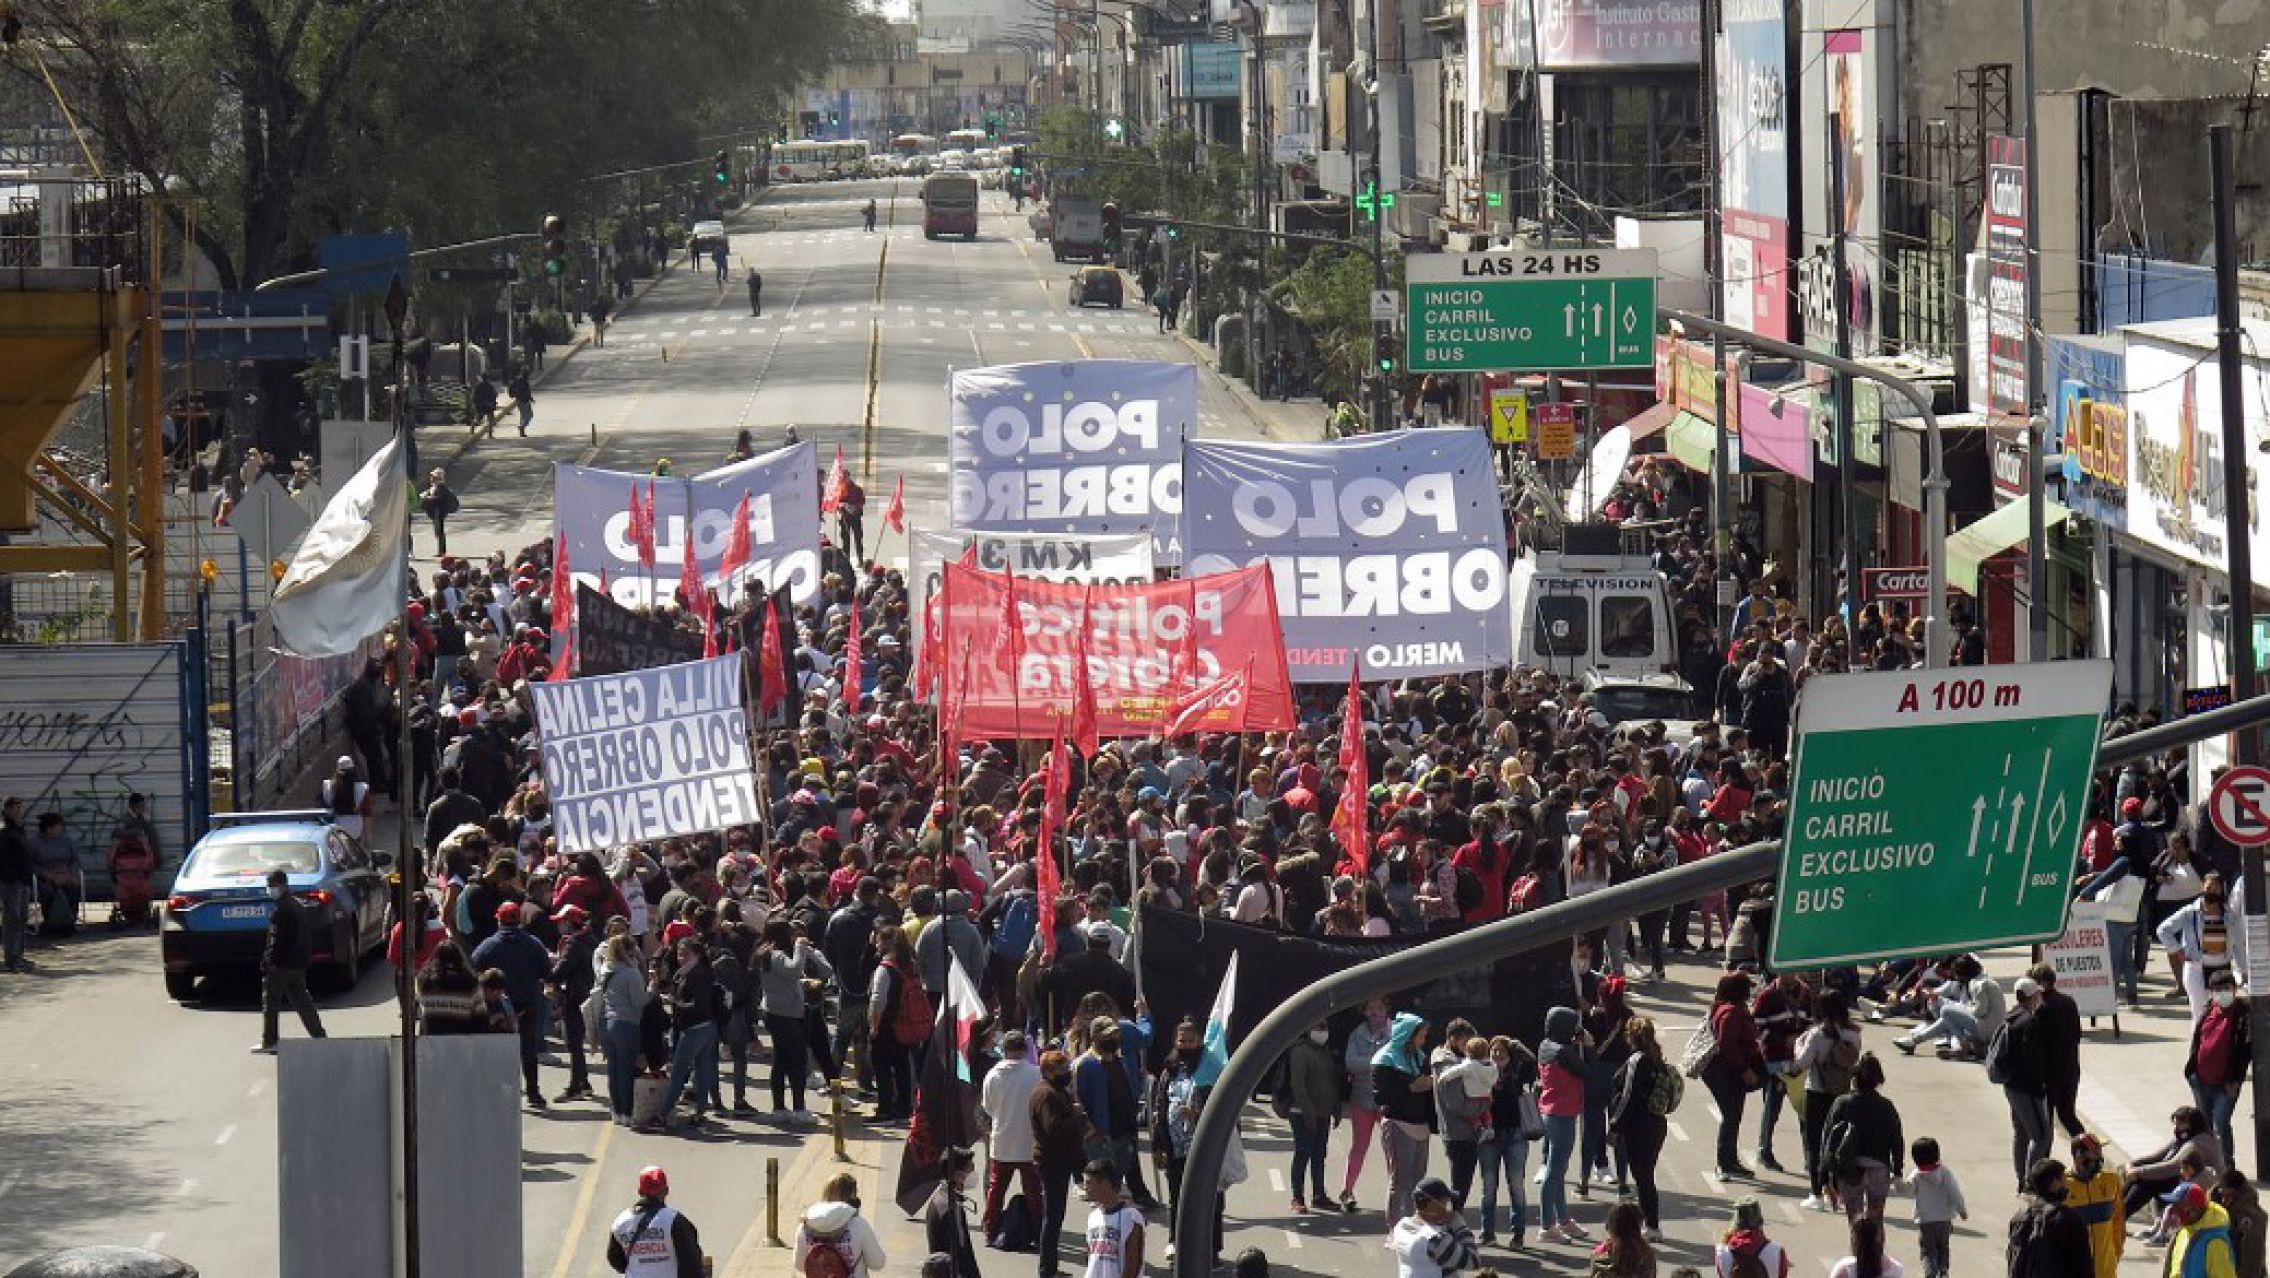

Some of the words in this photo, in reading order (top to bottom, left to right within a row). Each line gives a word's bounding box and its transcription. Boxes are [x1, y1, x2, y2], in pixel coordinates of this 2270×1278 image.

[1595, 3, 1653, 25] Instituto
[1463, 257, 1513, 276] LAS
[1523, 256, 1554, 275] 24
[1564, 255, 1600, 274] HS
[1425, 290, 1484, 305] INICIO
[1425, 309, 1495, 324] CARRIL
[1425, 327, 1532, 343] EXCLUSIVO
[1425, 347, 1464, 361] BUS
[1536, 578, 1653, 589] TELEVISION
[1877, 572, 1928, 590] Carta
[1897, 683, 1919, 713] A
[1932, 679, 1985, 711] 100
[1994, 682, 2021, 707] m
[1809, 775, 1885, 803] INICIO
[1805, 810, 1893, 840] CARRIL
[1799, 842, 1936, 877] EXCLUSIVO
[2031, 873, 2058, 886] BUS
[1795, 886, 1846, 914] BUS
